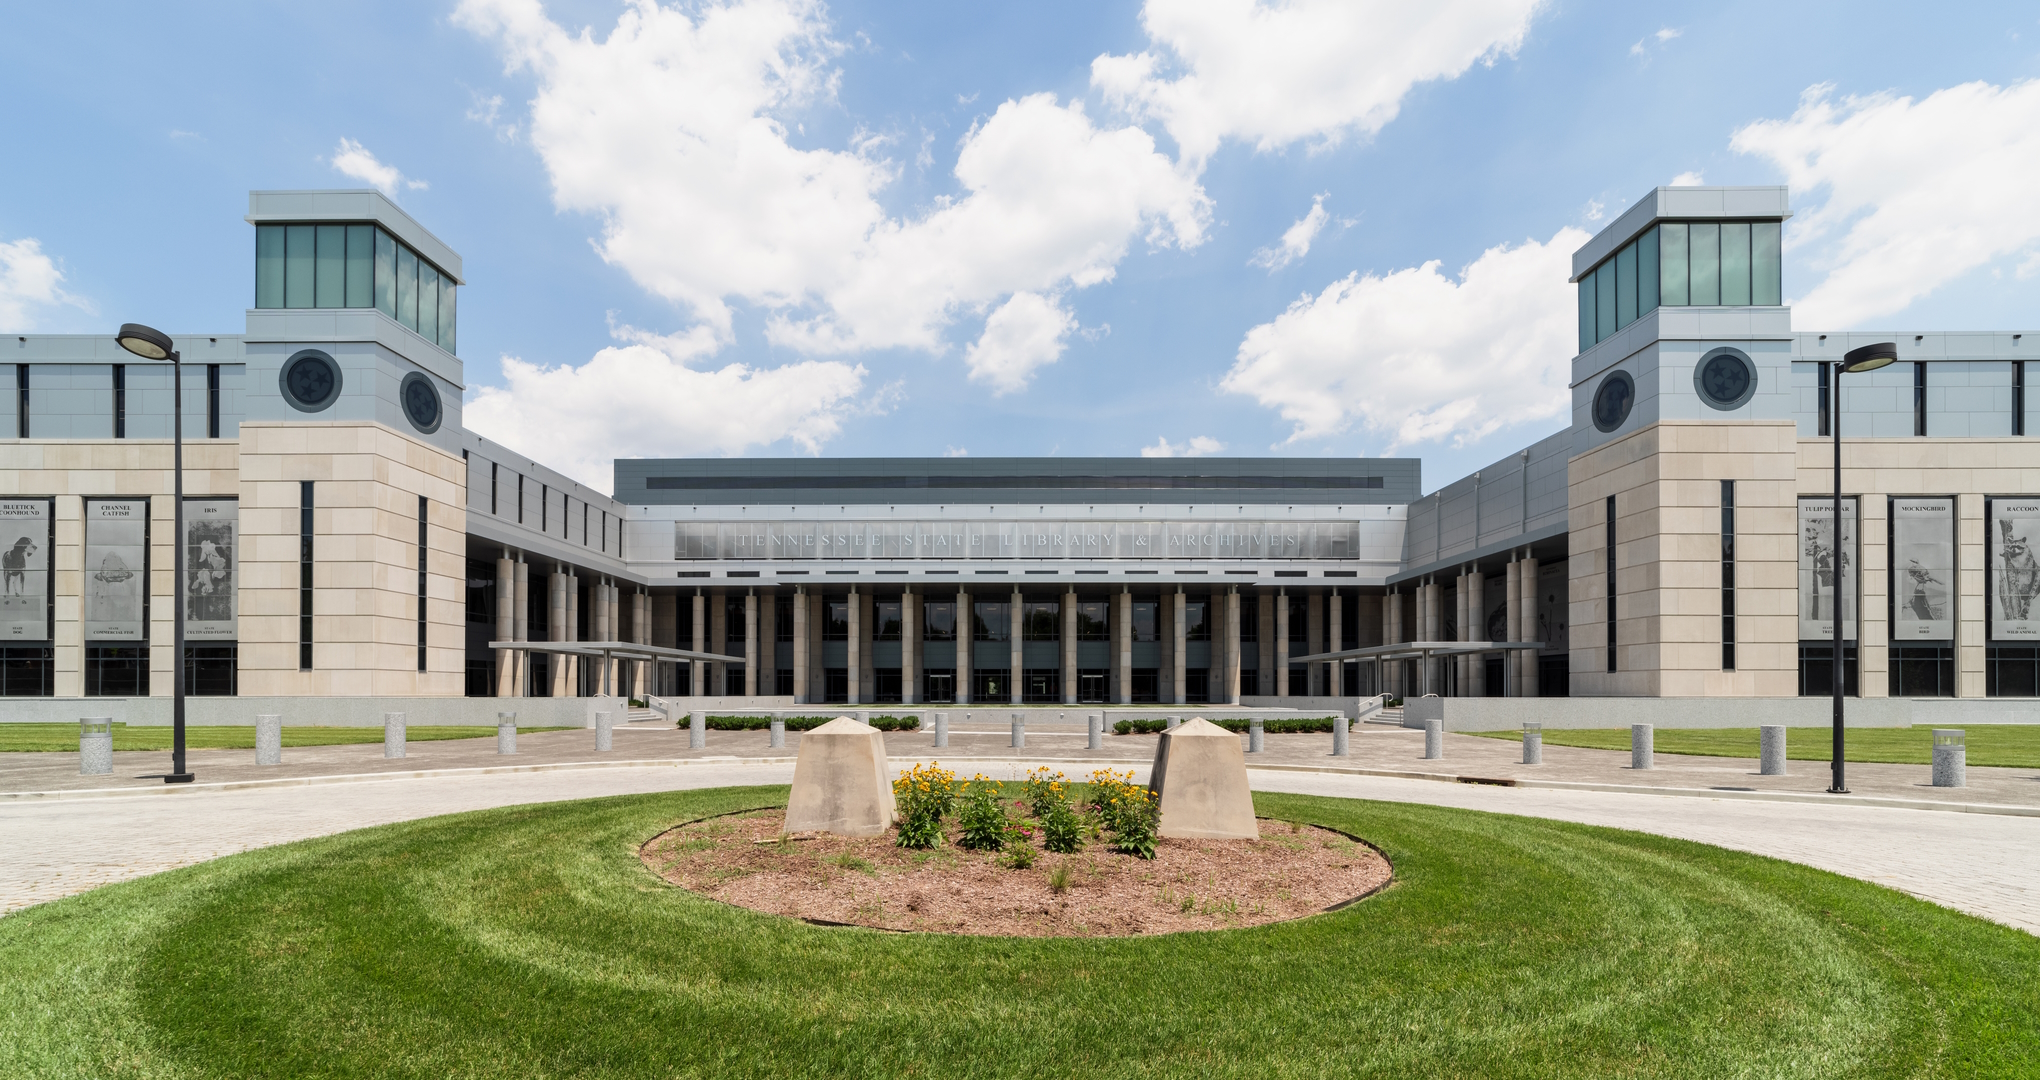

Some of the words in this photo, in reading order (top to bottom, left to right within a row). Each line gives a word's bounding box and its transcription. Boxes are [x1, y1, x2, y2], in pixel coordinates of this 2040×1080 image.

[739, 534, 881, 546] TENNESSEE
[904, 534, 981, 546] STATE
[1004, 534, 1113, 546] LIBRARY
[1135, 534, 1147, 546] &
[1169, 534, 1295, 546] ARCHIVES
